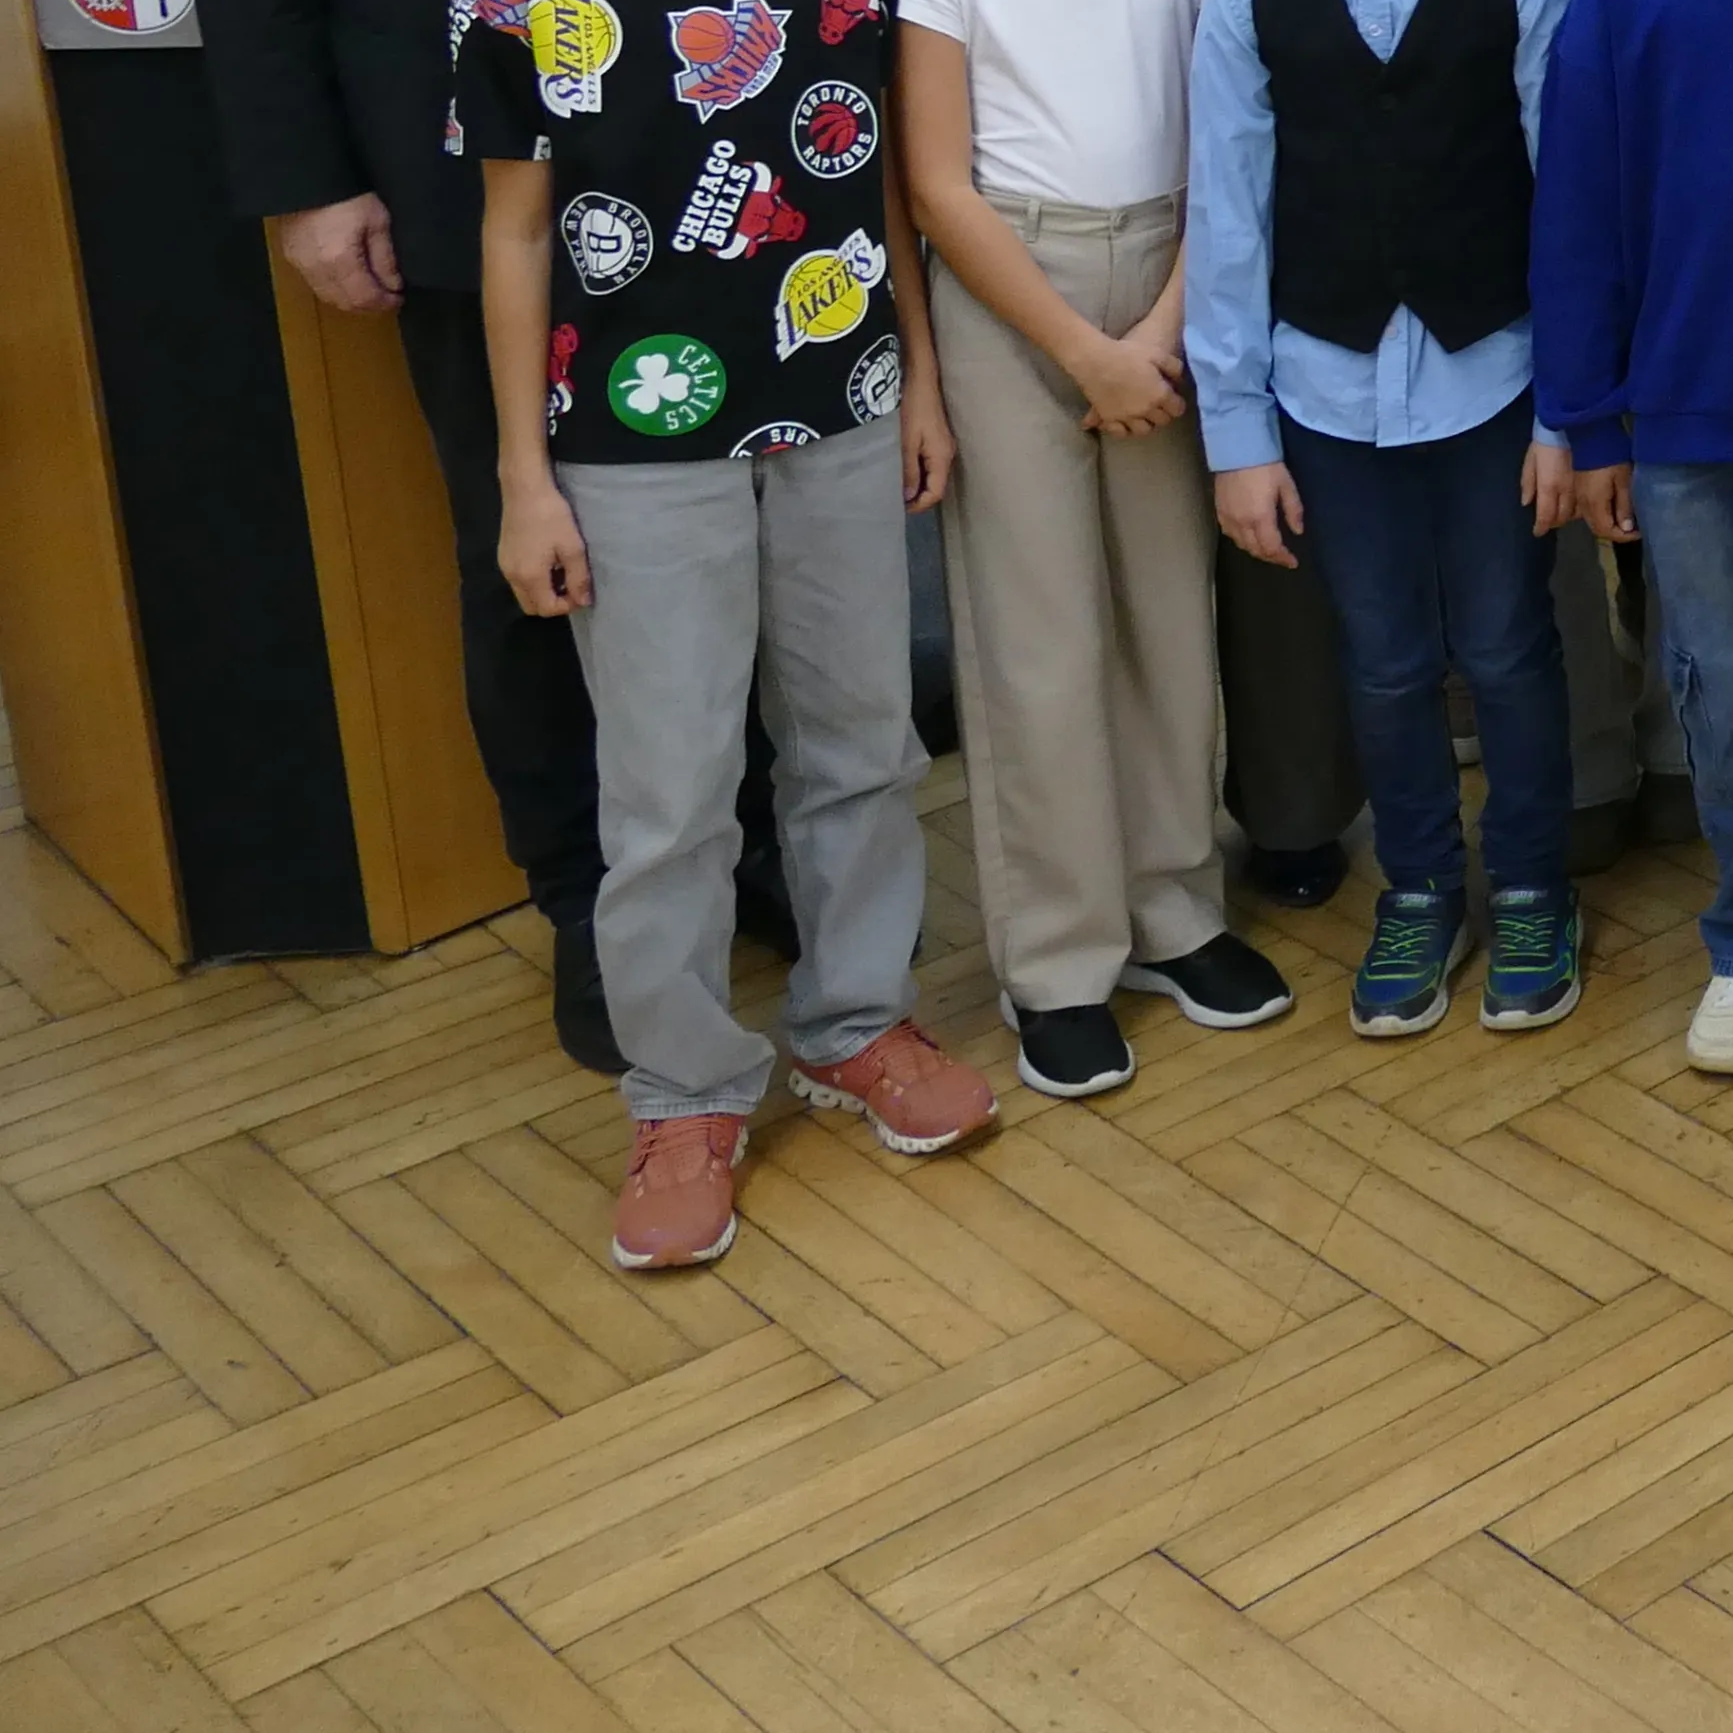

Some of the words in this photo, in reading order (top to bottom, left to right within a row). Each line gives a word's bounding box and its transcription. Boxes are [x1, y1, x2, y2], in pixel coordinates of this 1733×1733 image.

[682, 2, 782, 104] KNICKS
[798, 88, 866, 126] TORONTO
[803, 132, 873, 172] RAPTORS
[566, 201, 588, 232] NEW
[672, 139, 736, 253] CHICAGO
[702, 164, 753, 248] BULLS
[607, 202, 649, 285] BROOKLYN
[783, 247, 872, 346] LAKERS
[666, 344, 718, 431] CELTICS
